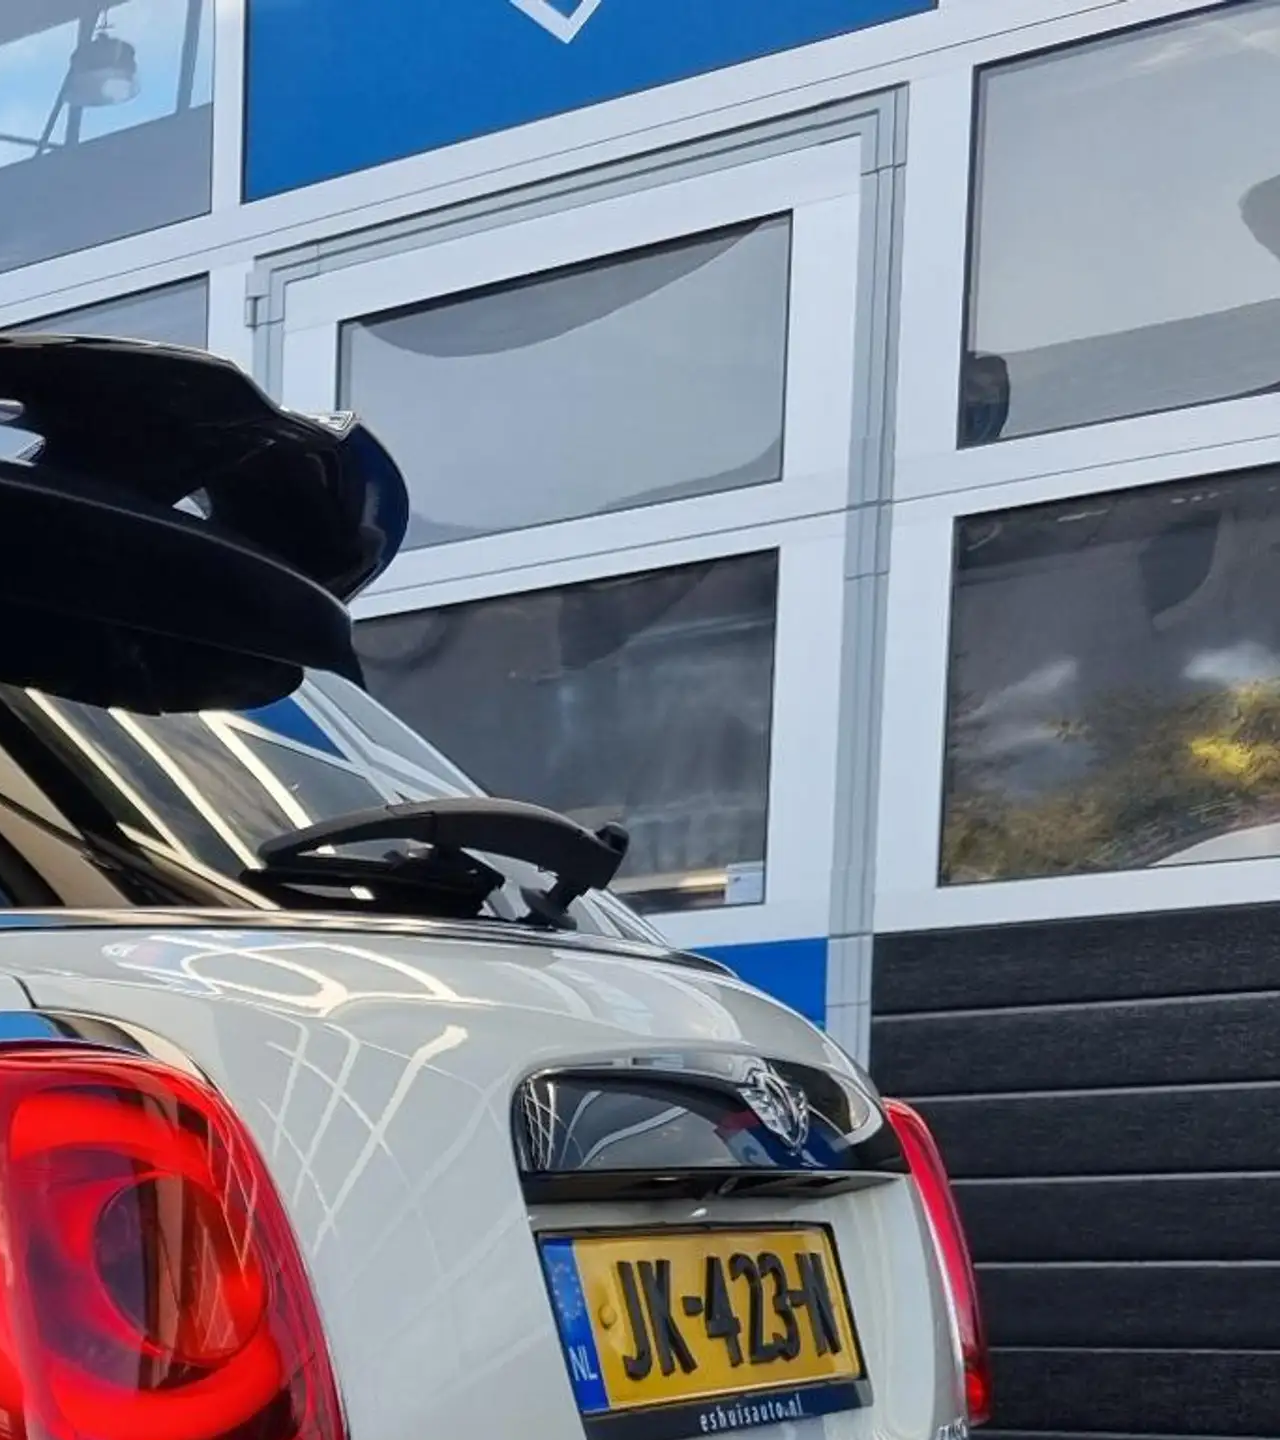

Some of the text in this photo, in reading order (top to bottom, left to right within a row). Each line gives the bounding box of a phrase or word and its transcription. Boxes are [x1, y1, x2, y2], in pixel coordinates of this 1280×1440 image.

[616, 1252, 842, 1381] JK-423-N
[568, 1345, 598, 1381] NL
[700, 1393, 803, 1432] eshuisauto.nl
